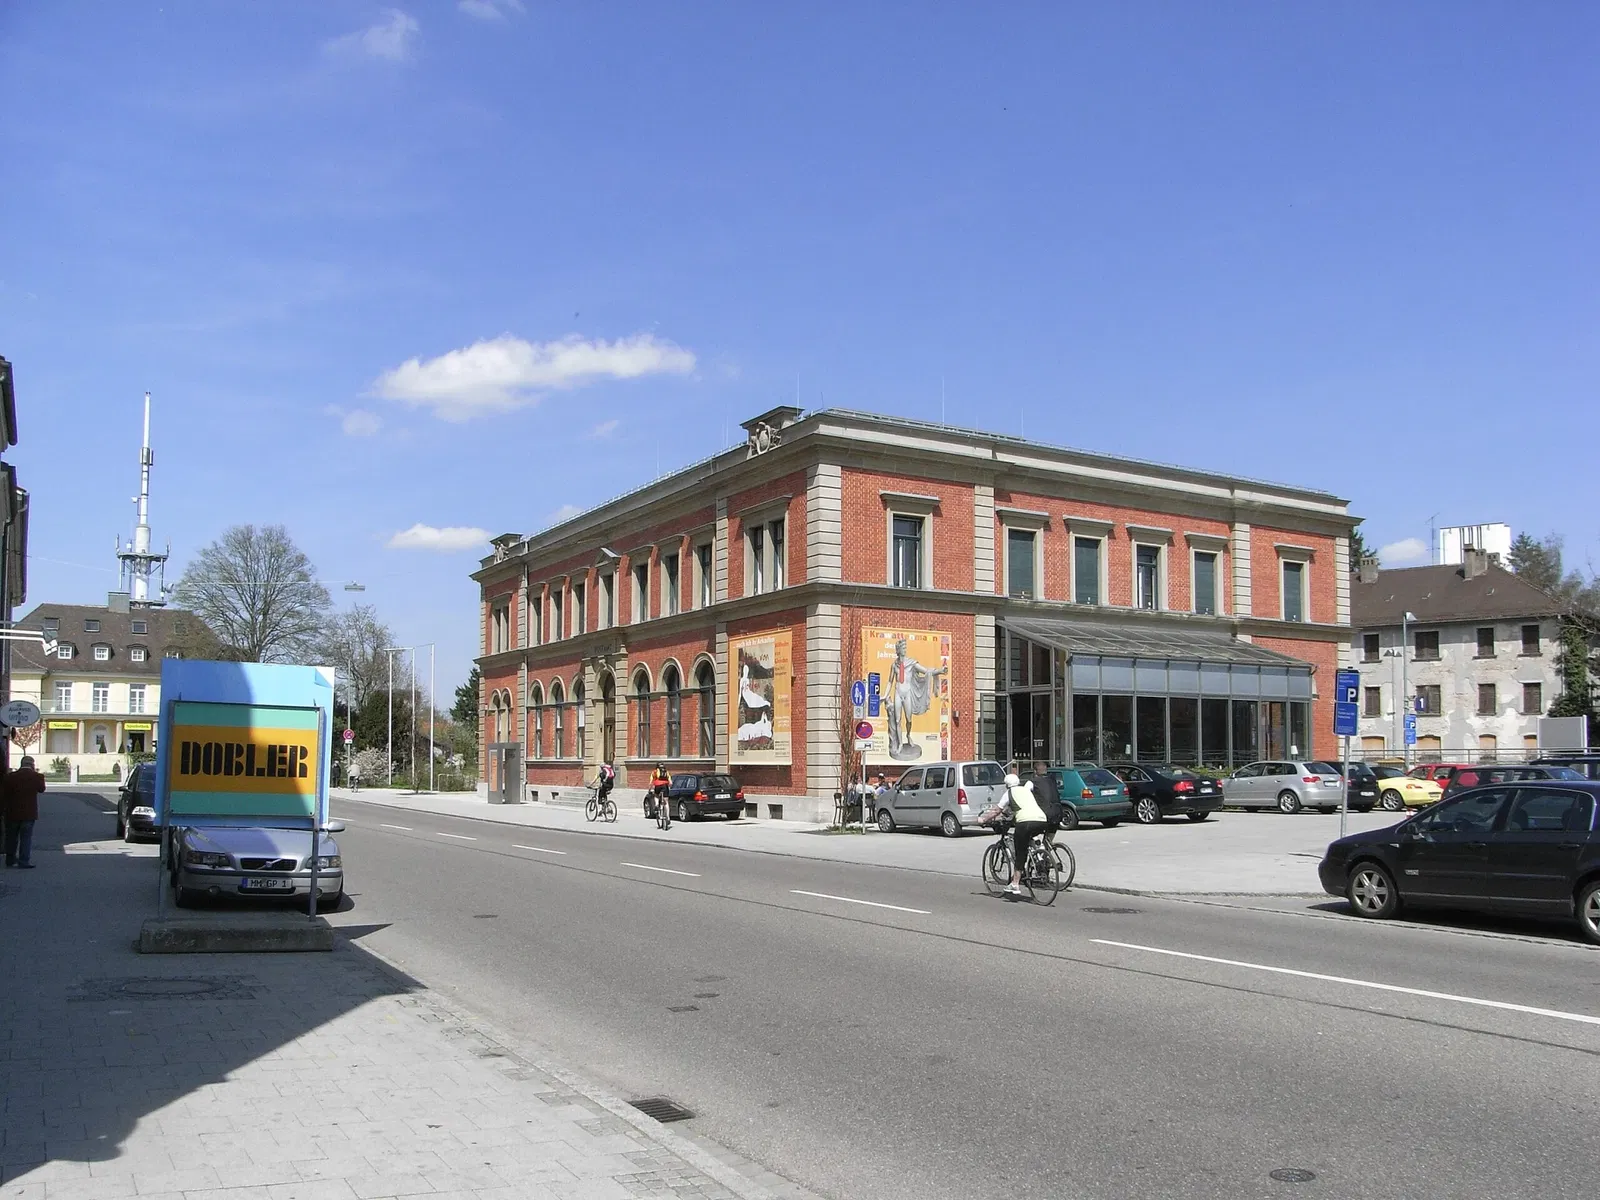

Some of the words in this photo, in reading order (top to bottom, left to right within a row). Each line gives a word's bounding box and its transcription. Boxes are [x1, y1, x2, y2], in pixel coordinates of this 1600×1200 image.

[869, 630, 938, 642] Krawattenmann
[874, 684, 880, 695] P
[1347, 687, 1357, 702] P
[1419, 697, 1424, 708] 1
[180, 741, 308, 778] DOBLER
[251, 879, 262, 888] MM
[266, 879, 278, 888] GP
[281, 880, 287, 888] 1
